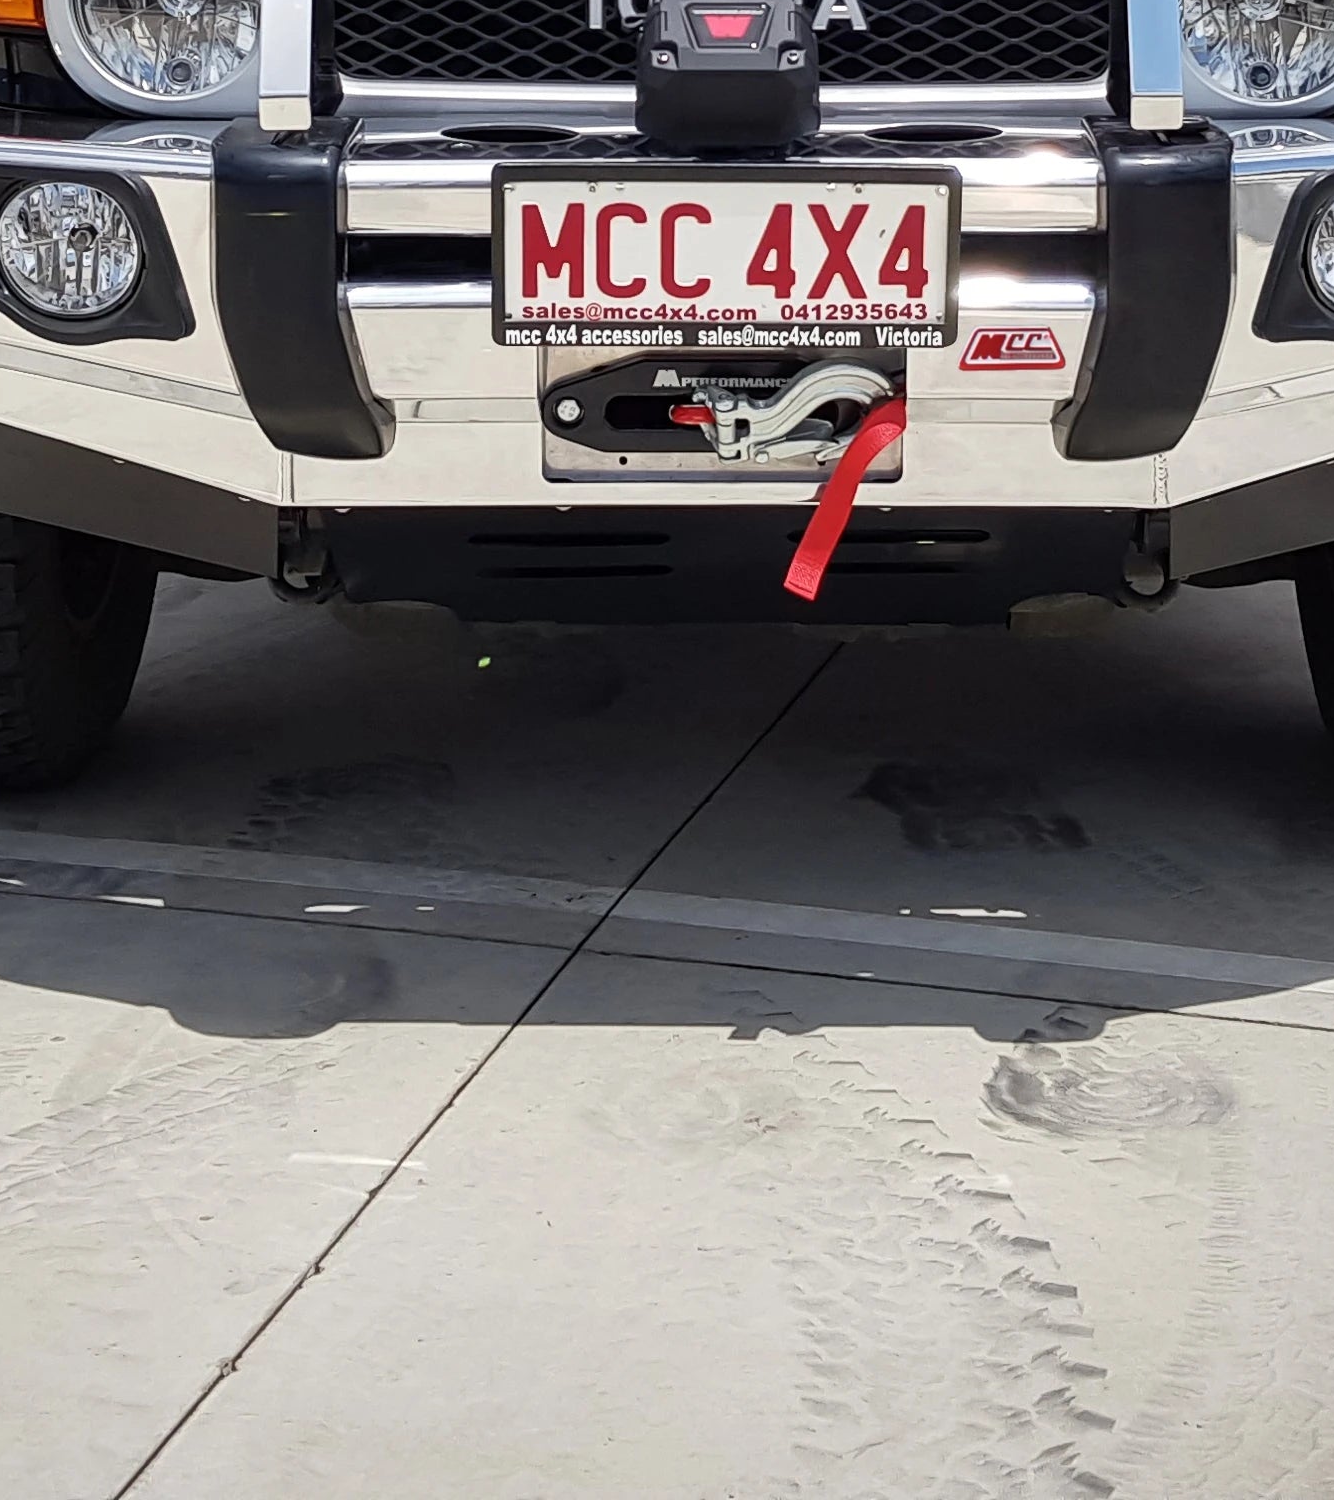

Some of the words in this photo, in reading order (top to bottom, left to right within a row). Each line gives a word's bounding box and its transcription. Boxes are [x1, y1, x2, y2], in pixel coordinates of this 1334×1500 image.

[521, 202, 712, 299] MCC
[746, 203, 929, 299] 4X4
[522, 303, 757, 321] sales@mcc4x4.com
[780, 303, 928, 321] 0412935643
[505, 329, 541, 346] mcc
[545, 324, 578, 345] 4x4
[581, 326, 683, 346] accessories
[697, 325, 861, 347] sales@mcc4x4.com
[875, 326, 943, 347] Victoria
[971, 334, 1053, 359] MCC
